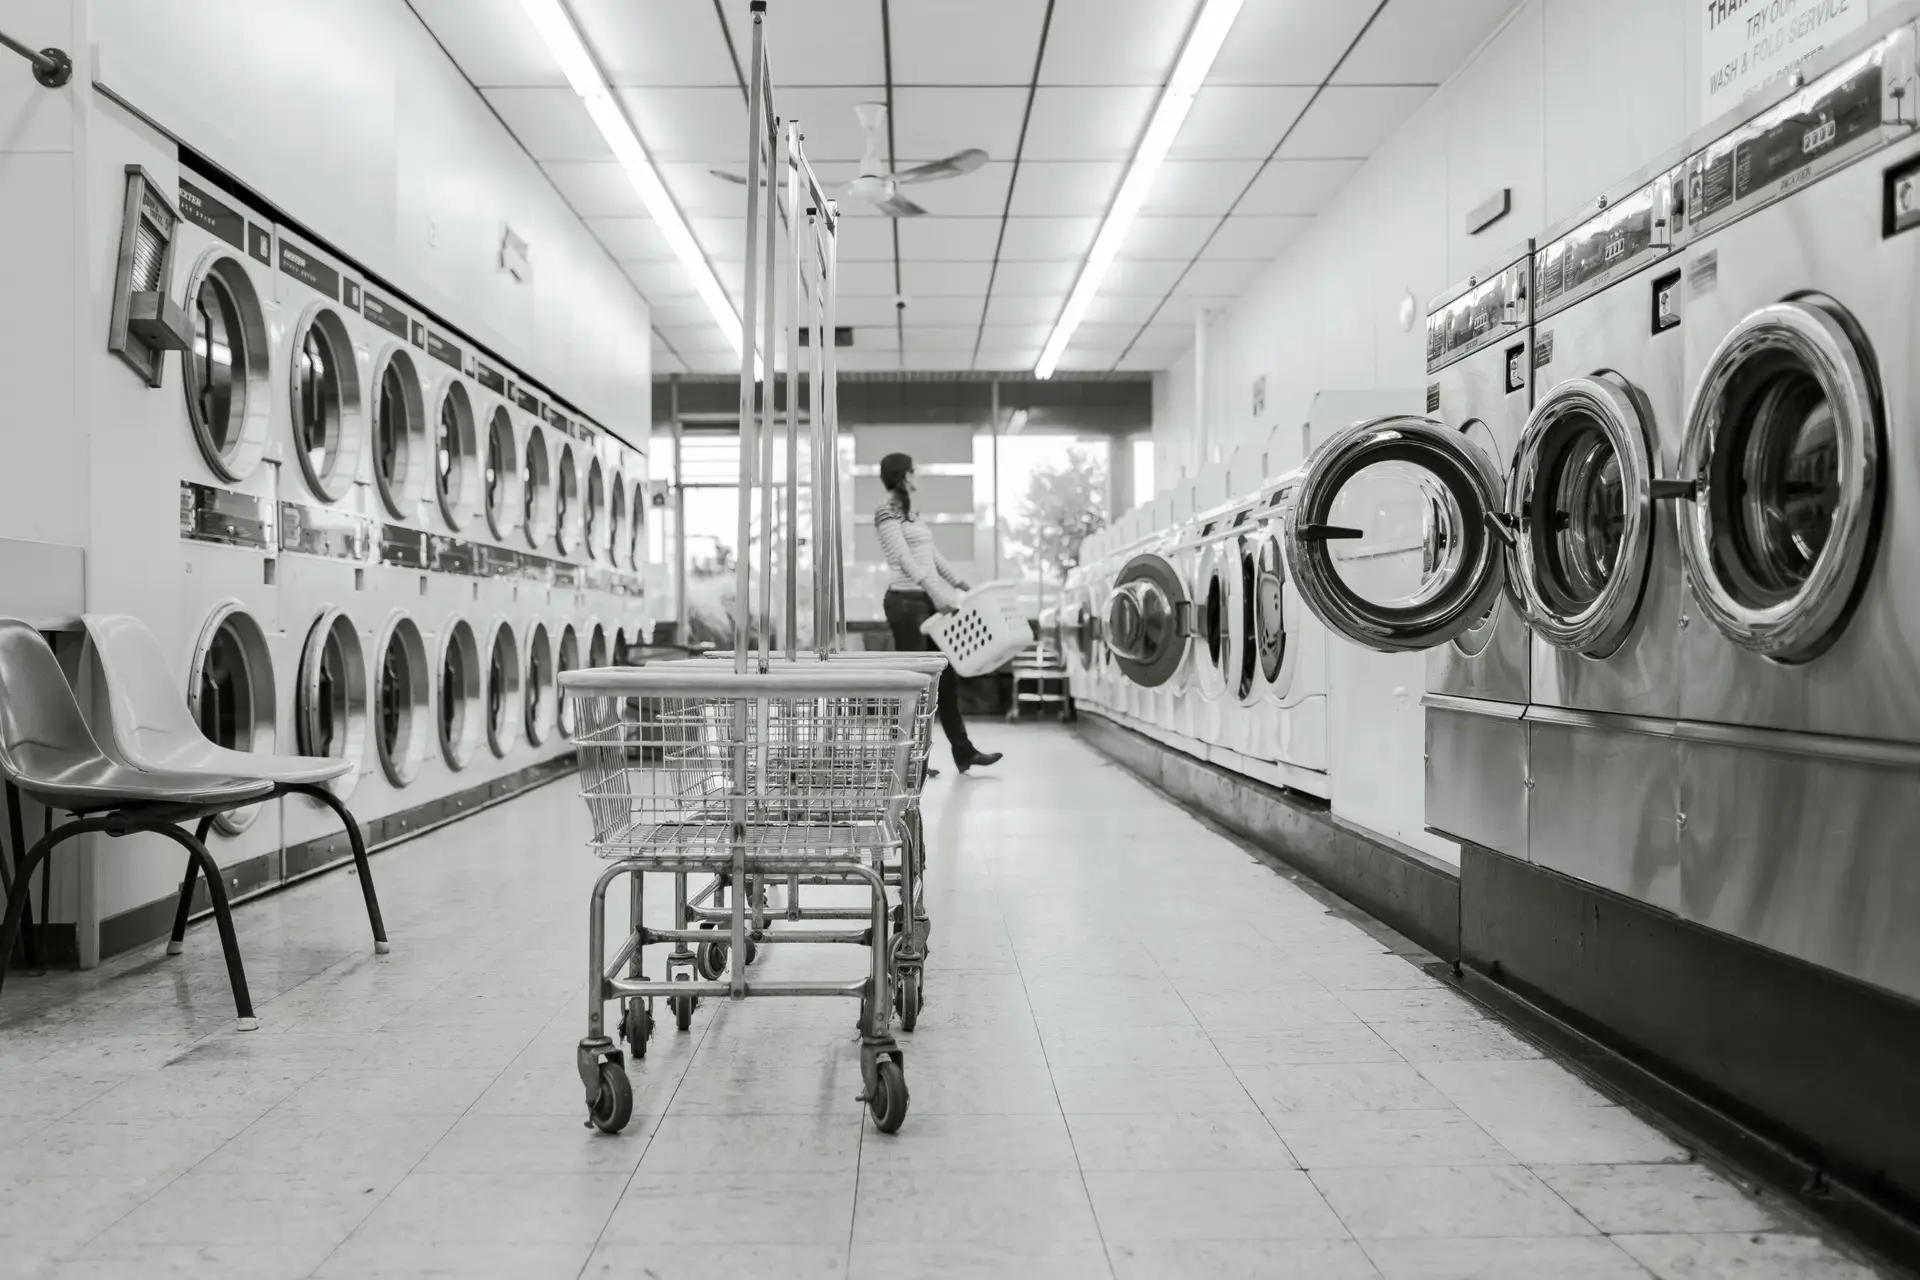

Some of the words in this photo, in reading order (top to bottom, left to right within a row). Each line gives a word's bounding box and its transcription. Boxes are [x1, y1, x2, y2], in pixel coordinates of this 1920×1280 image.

[1747, 4, 1769, 41] TRY
[1709, 57, 1739, 96] WASH
[1740, 50, 1748, 75] &
[1752, 27, 1784, 69] FOLD
